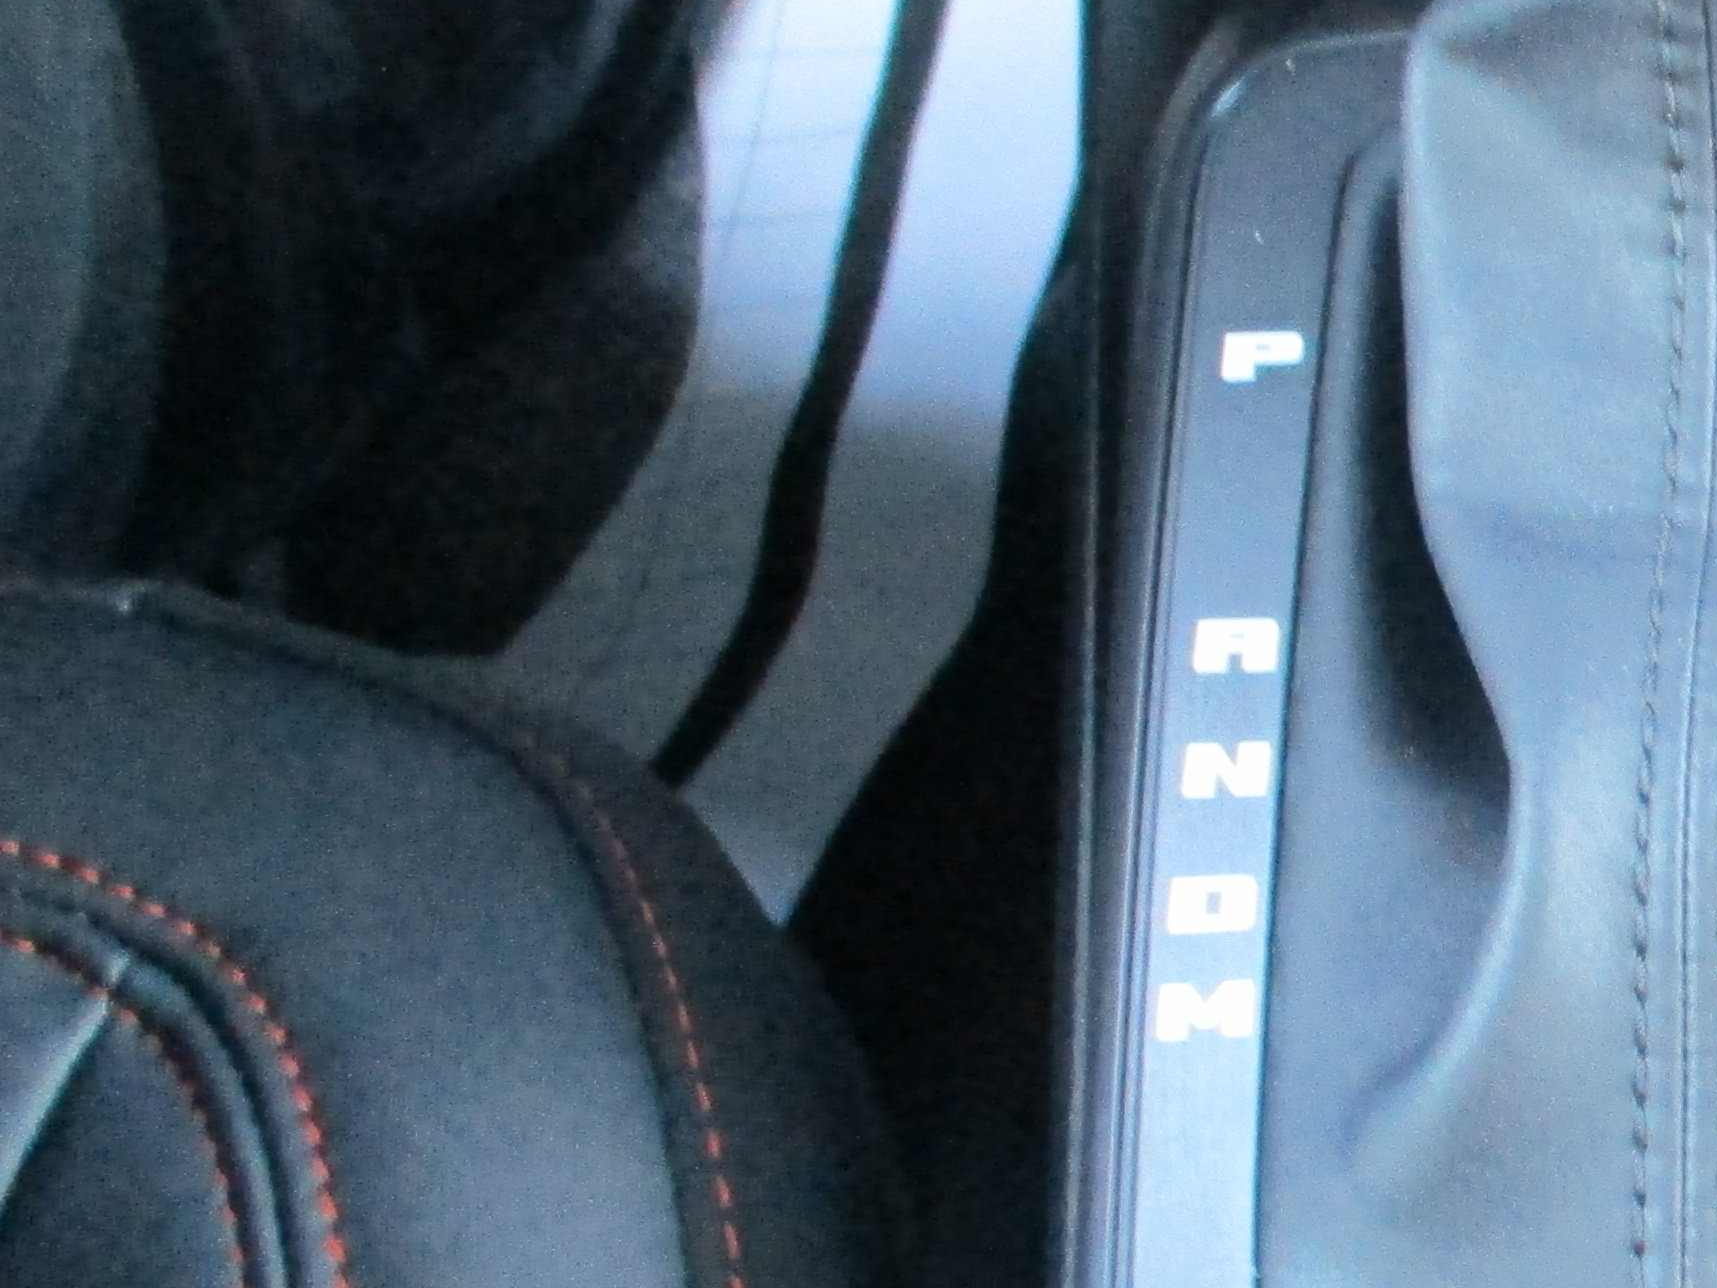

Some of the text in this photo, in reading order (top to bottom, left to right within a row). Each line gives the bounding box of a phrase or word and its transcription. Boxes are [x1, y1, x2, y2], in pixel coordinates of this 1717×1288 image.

[1219, 330, 1306, 383] P
[1191, 617, 1281, 675] R
[1180, 741, 1271, 800] N
[1165, 874, 1259, 935] D
[1154, 978, 1256, 1042] M
